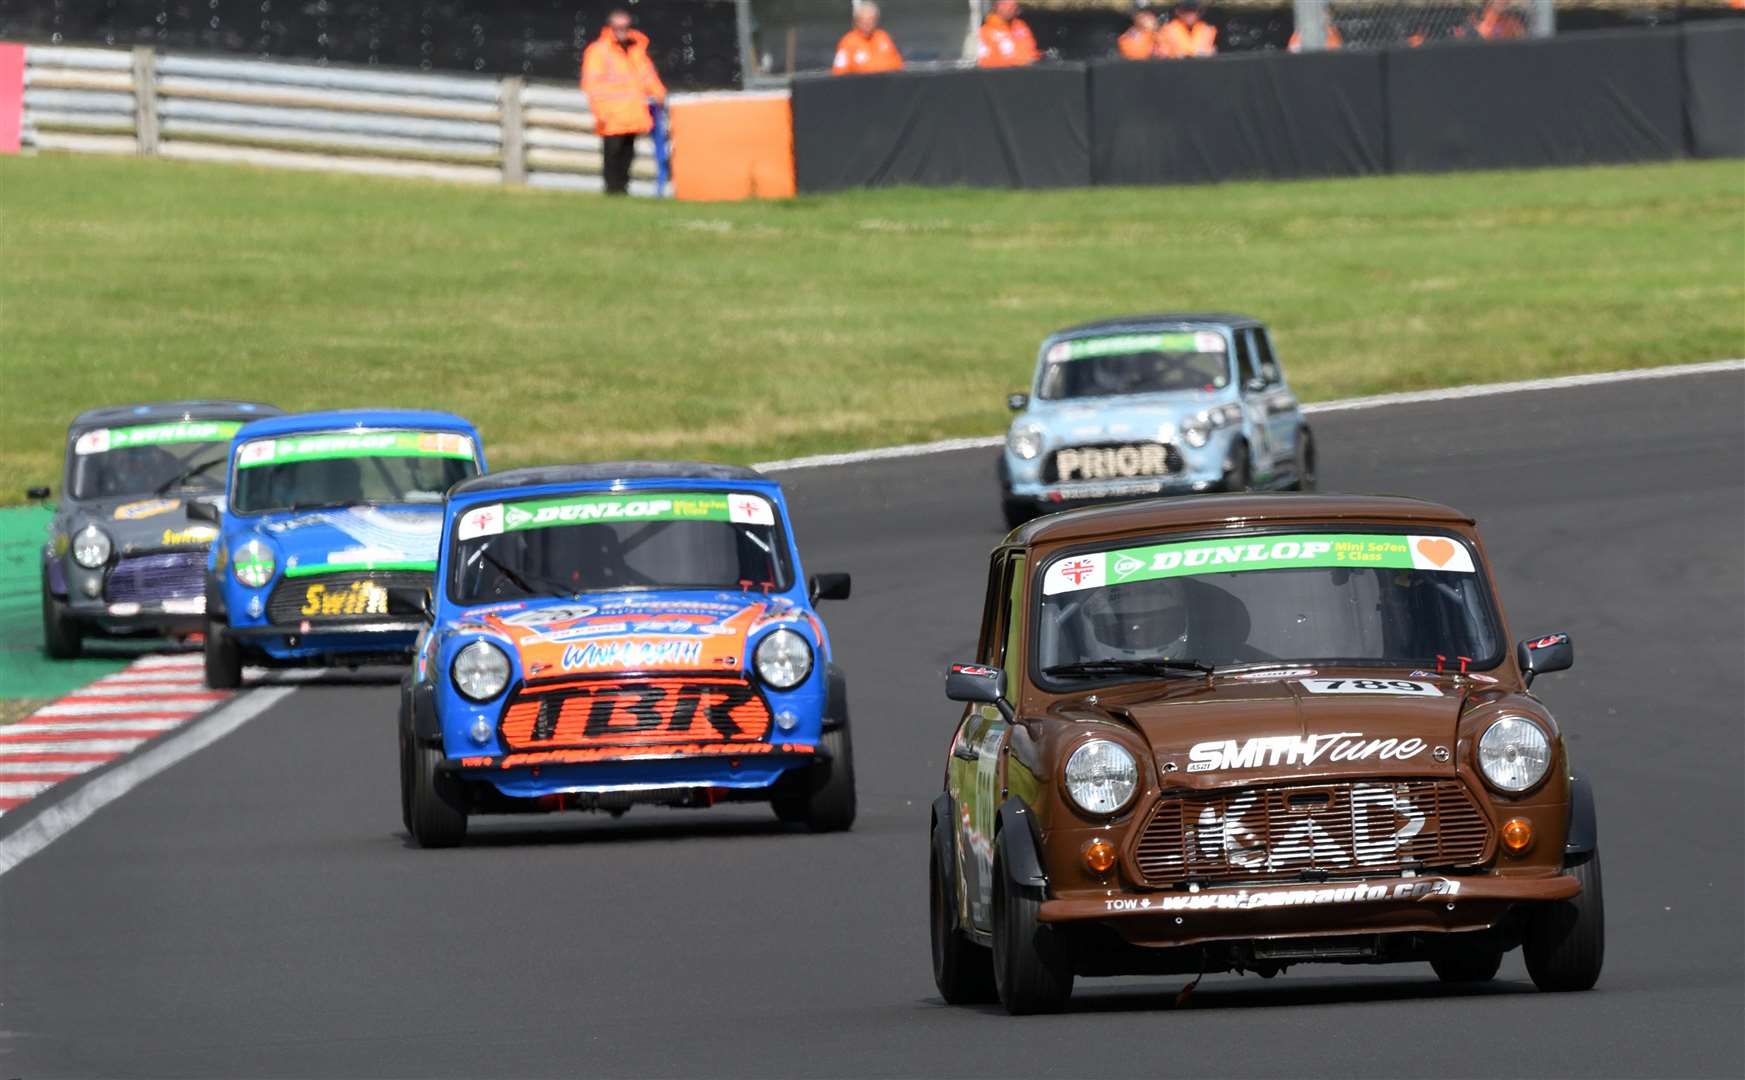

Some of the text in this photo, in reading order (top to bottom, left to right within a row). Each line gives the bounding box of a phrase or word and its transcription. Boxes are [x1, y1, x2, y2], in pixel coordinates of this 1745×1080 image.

[1056, 444, 1168, 481] PRIOR
[532, 499, 672, 522] DUNLOP
[1148, 541, 1331, 571] DUNLOP
[1335, 542, 1363, 552] Mini
[1348, 551, 1383, 561] Class
[1313, 679, 1425, 692] 789
[516, 685, 750, 741] TBR
[1104, 898, 1138, 910] TOW
